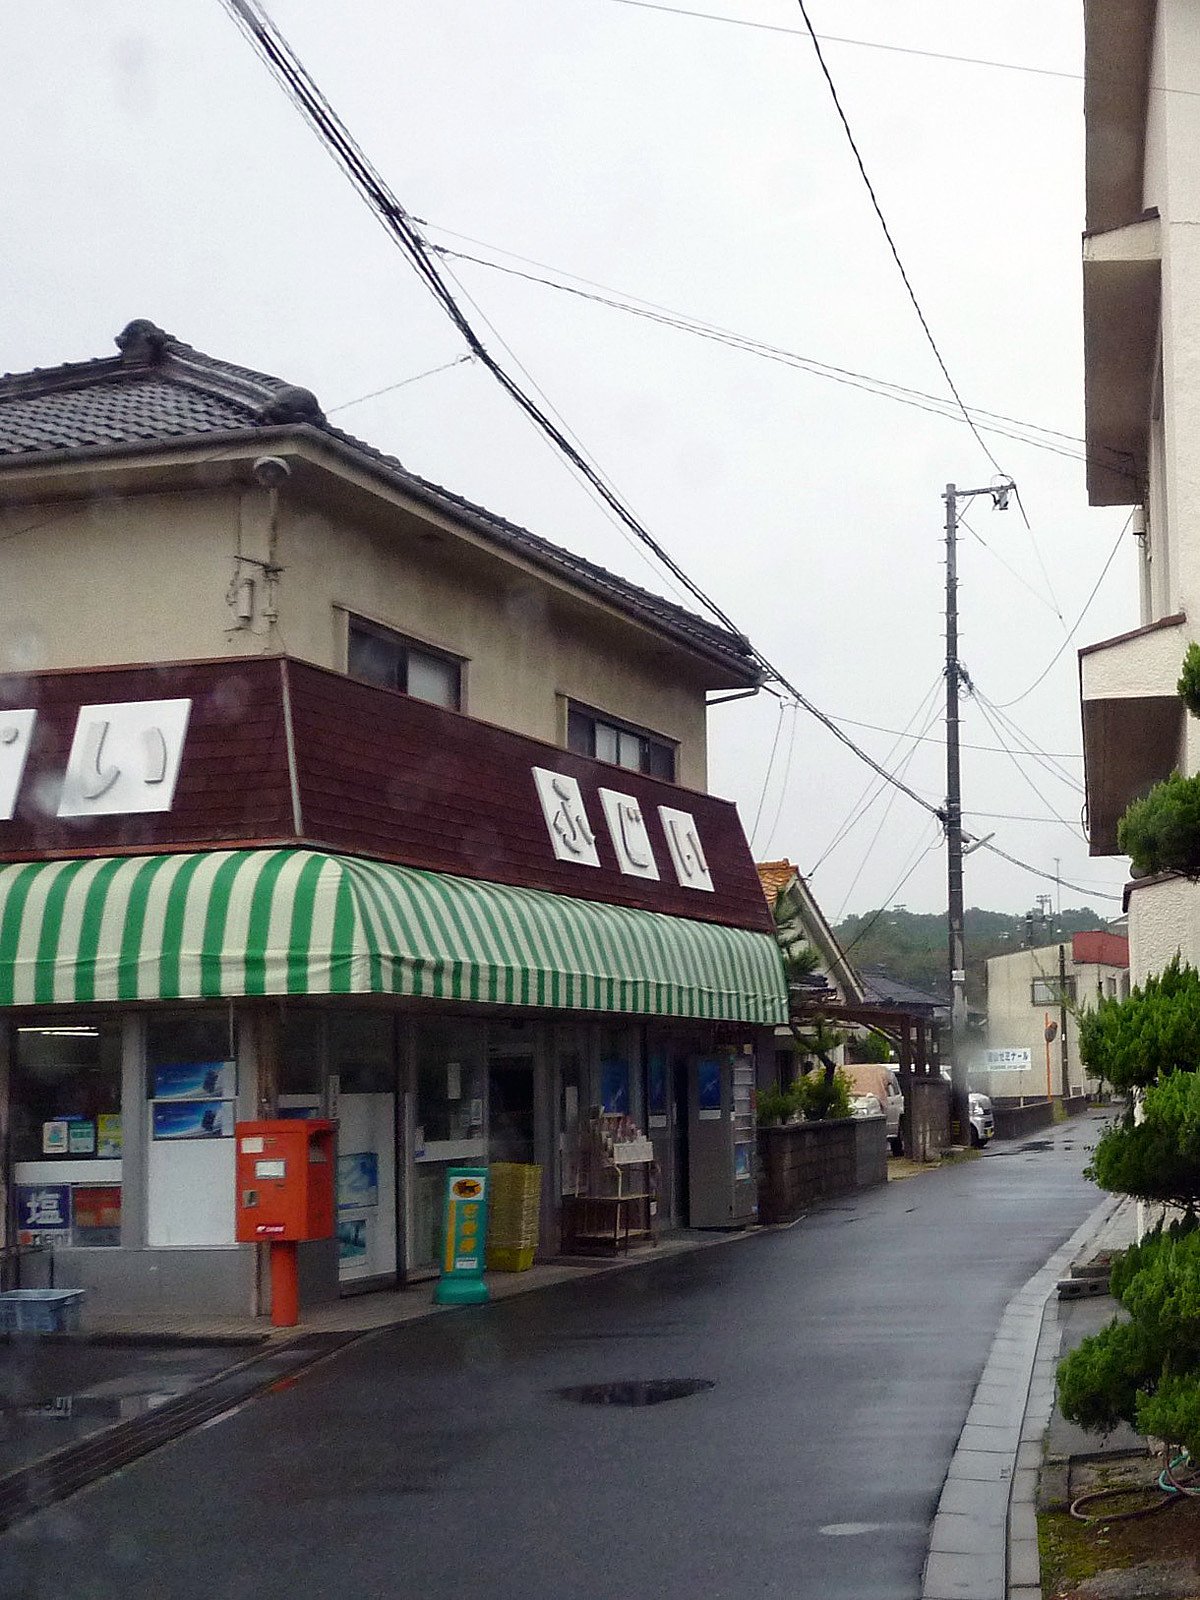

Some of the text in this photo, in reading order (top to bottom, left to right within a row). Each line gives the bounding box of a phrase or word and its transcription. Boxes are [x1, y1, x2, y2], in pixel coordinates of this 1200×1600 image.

[549, 776, 710, 879] ふじい
[26, 1190, 63, 1224] 塩
